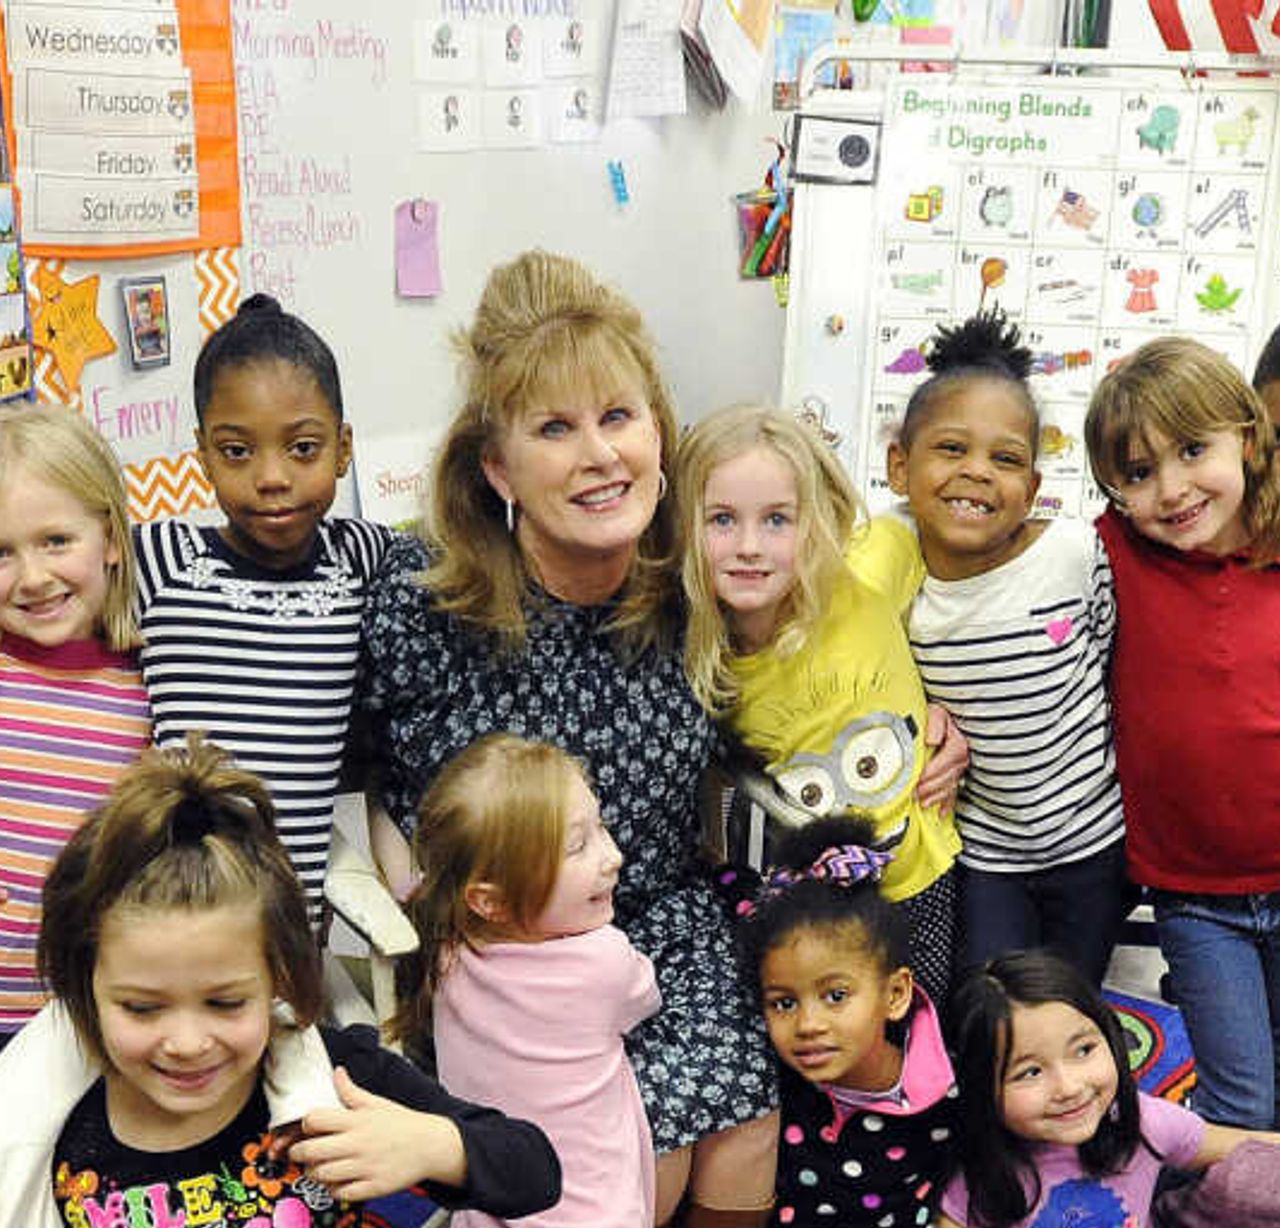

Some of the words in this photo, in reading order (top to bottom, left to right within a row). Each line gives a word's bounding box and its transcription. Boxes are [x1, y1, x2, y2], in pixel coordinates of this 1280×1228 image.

[24, 24, 156, 57] Wednesday
[77, 86, 165, 115] Thursday
[1019, 93, 1093, 118] Blends
[1127, 95, 1148, 112] ch
[947, 125, 1048, 157] Digraphs
[96, 150, 158, 176] Friday
[81, 196, 169, 223] Saturday
